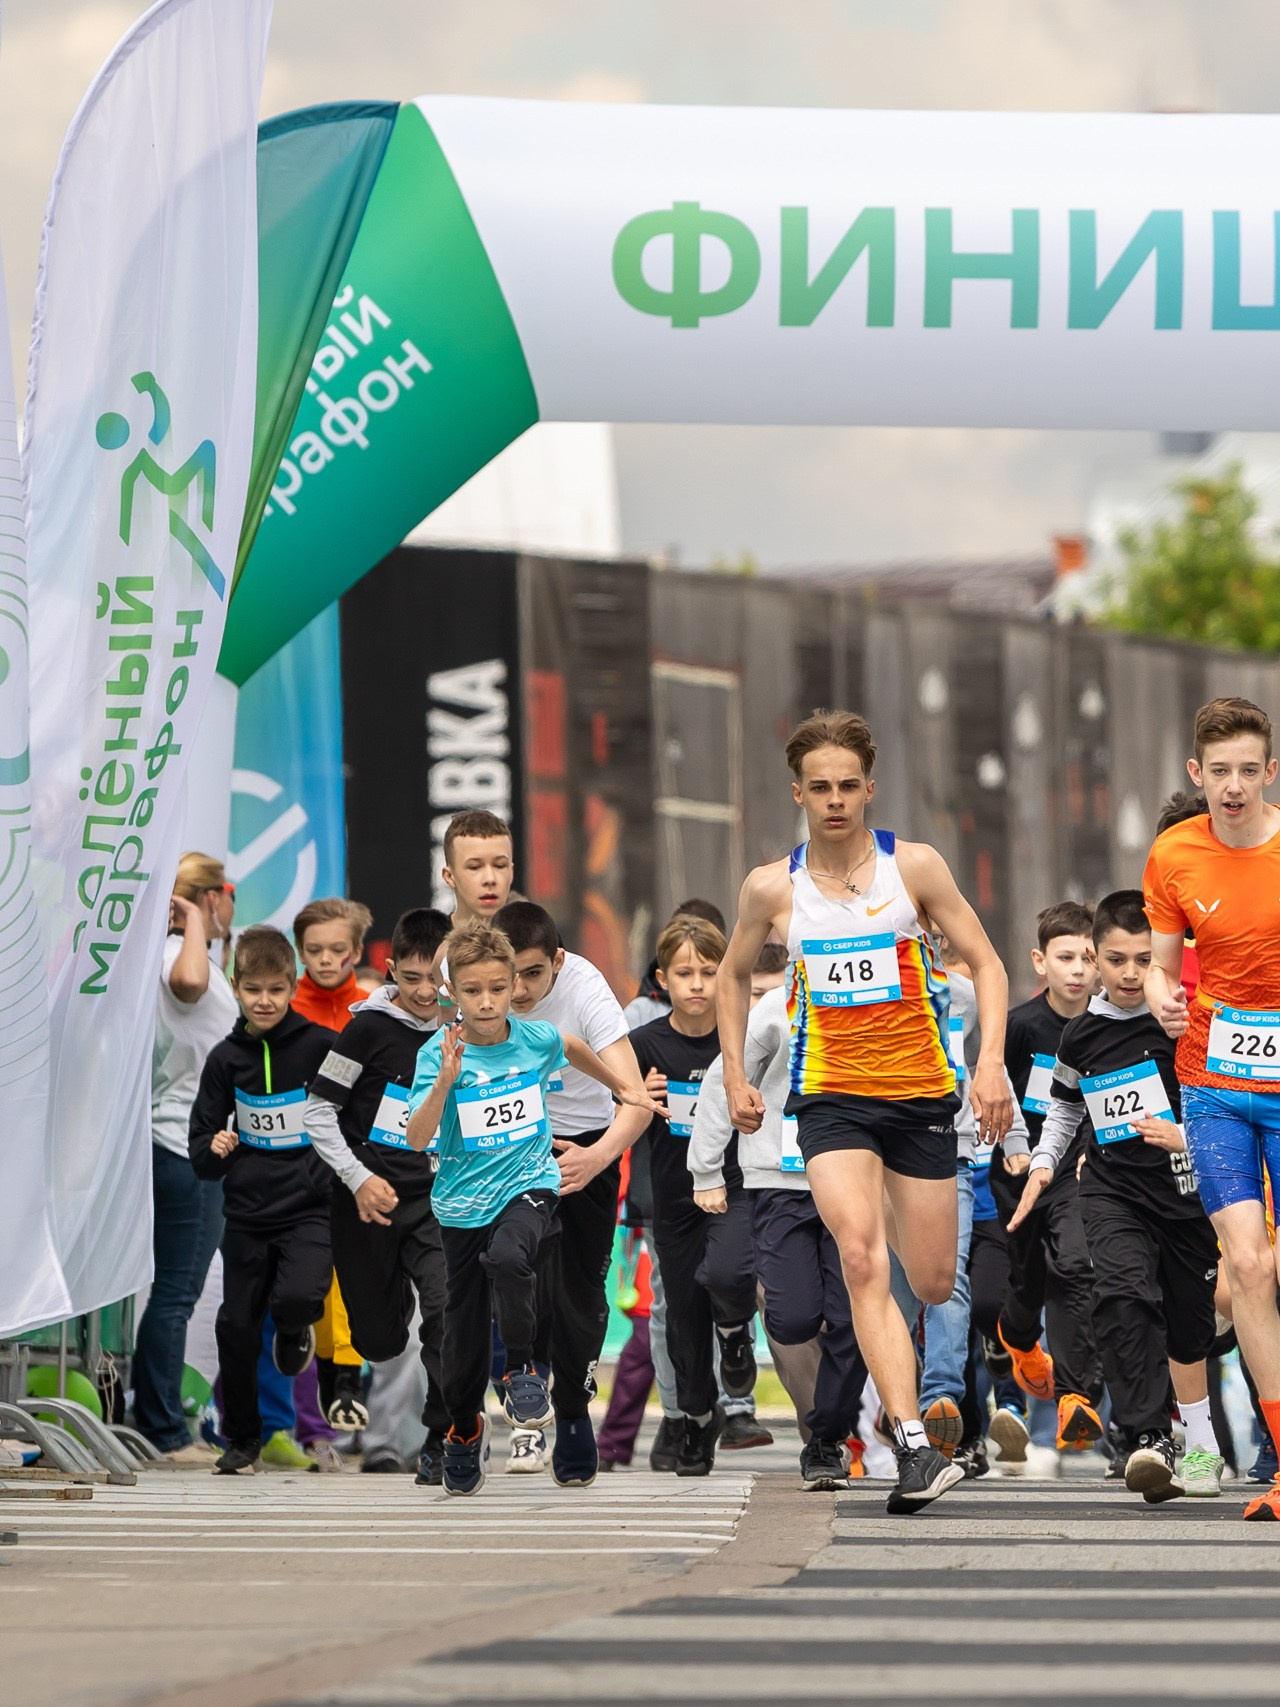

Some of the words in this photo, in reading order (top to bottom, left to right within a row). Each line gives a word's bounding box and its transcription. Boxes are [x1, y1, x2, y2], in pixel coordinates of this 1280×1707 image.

[264, 339, 433, 516] рафон
[79, 609, 203, 995] марафон
[853, 940, 872, 948] KIDS
[828, 959, 874, 984] 418
[822, 993, 838, 1003] 420
[1231, 1033, 1277, 1057] 226
[1219, 1061, 1237, 1073] 420
[1118, 1071, 1134, 1081] KIDS
[507, 1081, 522, 1089] KIDS
[1104, 1090, 1144, 1118] 422
[483, 1099, 526, 1127] 252
[249, 1112, 286, 1131] 331
[1104, 1128, 1117, 1139] 420
[477, 1136, 495, 1147] 420
